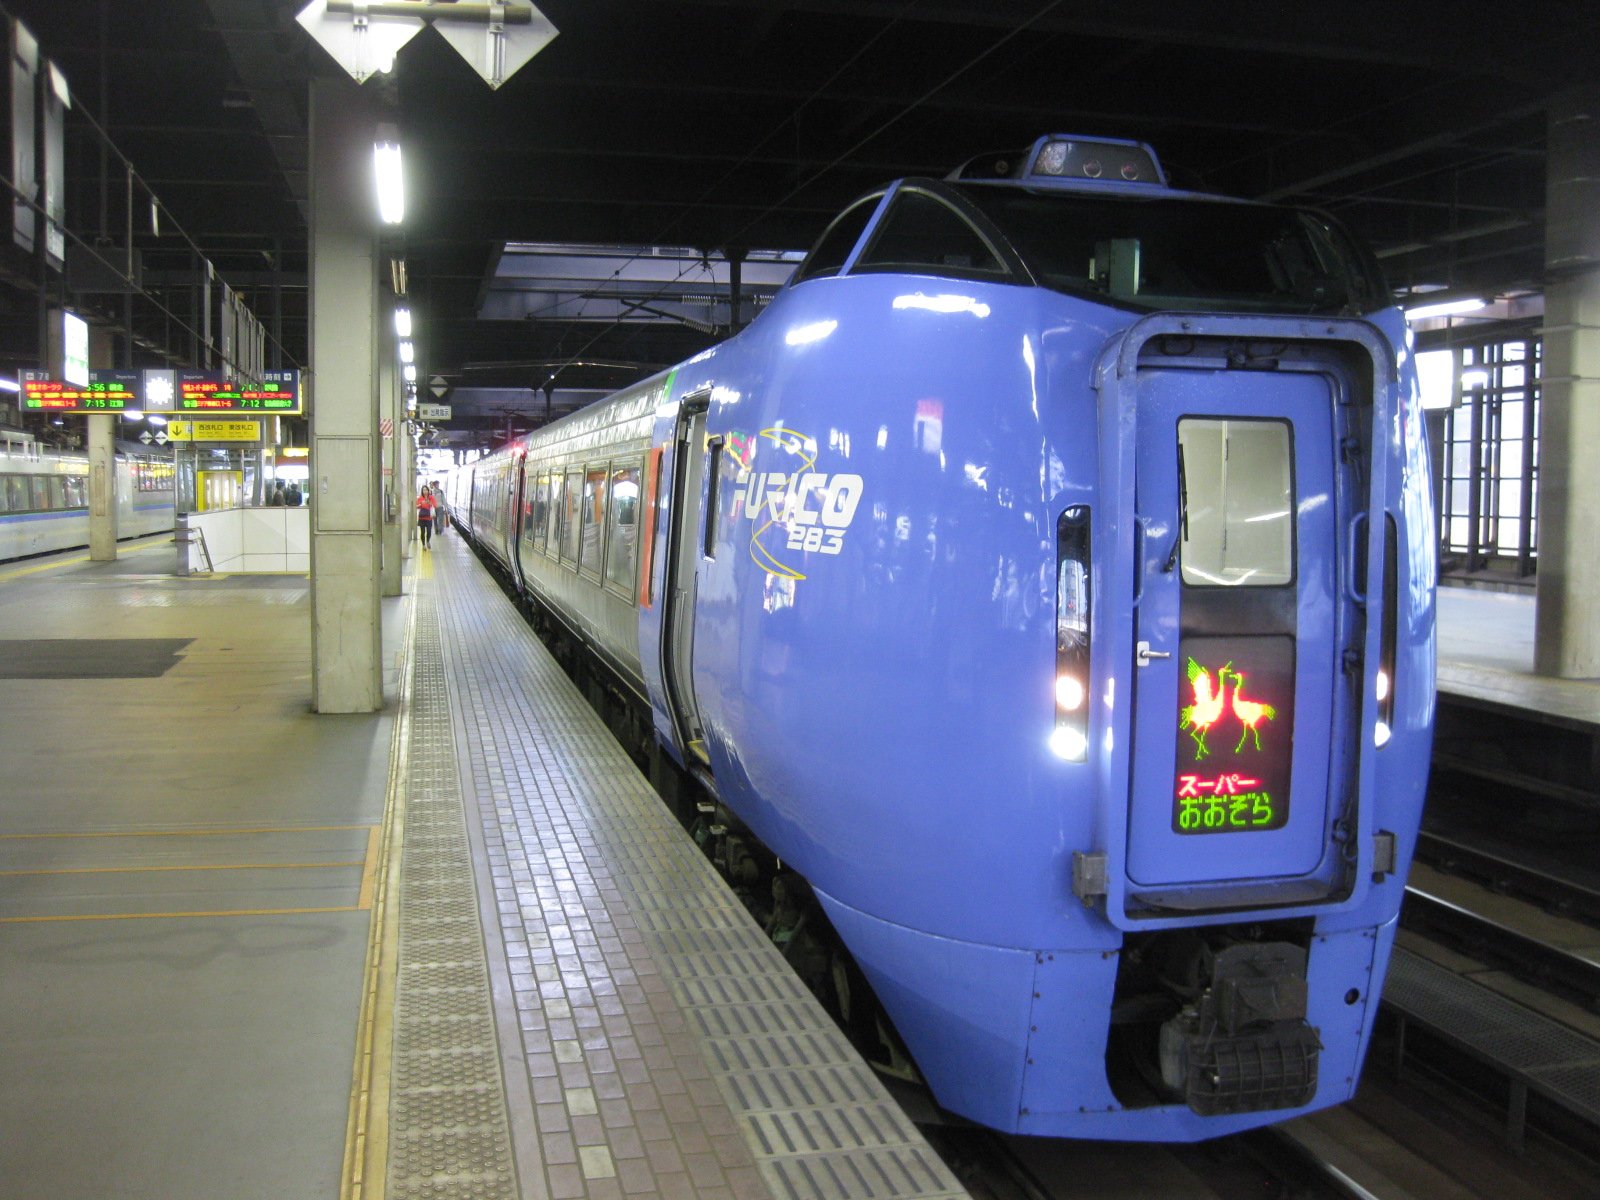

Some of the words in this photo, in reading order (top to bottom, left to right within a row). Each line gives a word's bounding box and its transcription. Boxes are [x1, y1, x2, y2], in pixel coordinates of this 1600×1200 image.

[86, 400, 105, 408] 7:15
[241, 400, 259, 408] 7:12
[409, 423, 415, 434] 8
[731, 472, 864, 528] FURICO
[787, 526, 847, 555] 283
[1178, 774, 1256, 796] スーパー
[1179, 792, 1272, 829] おおぞら
